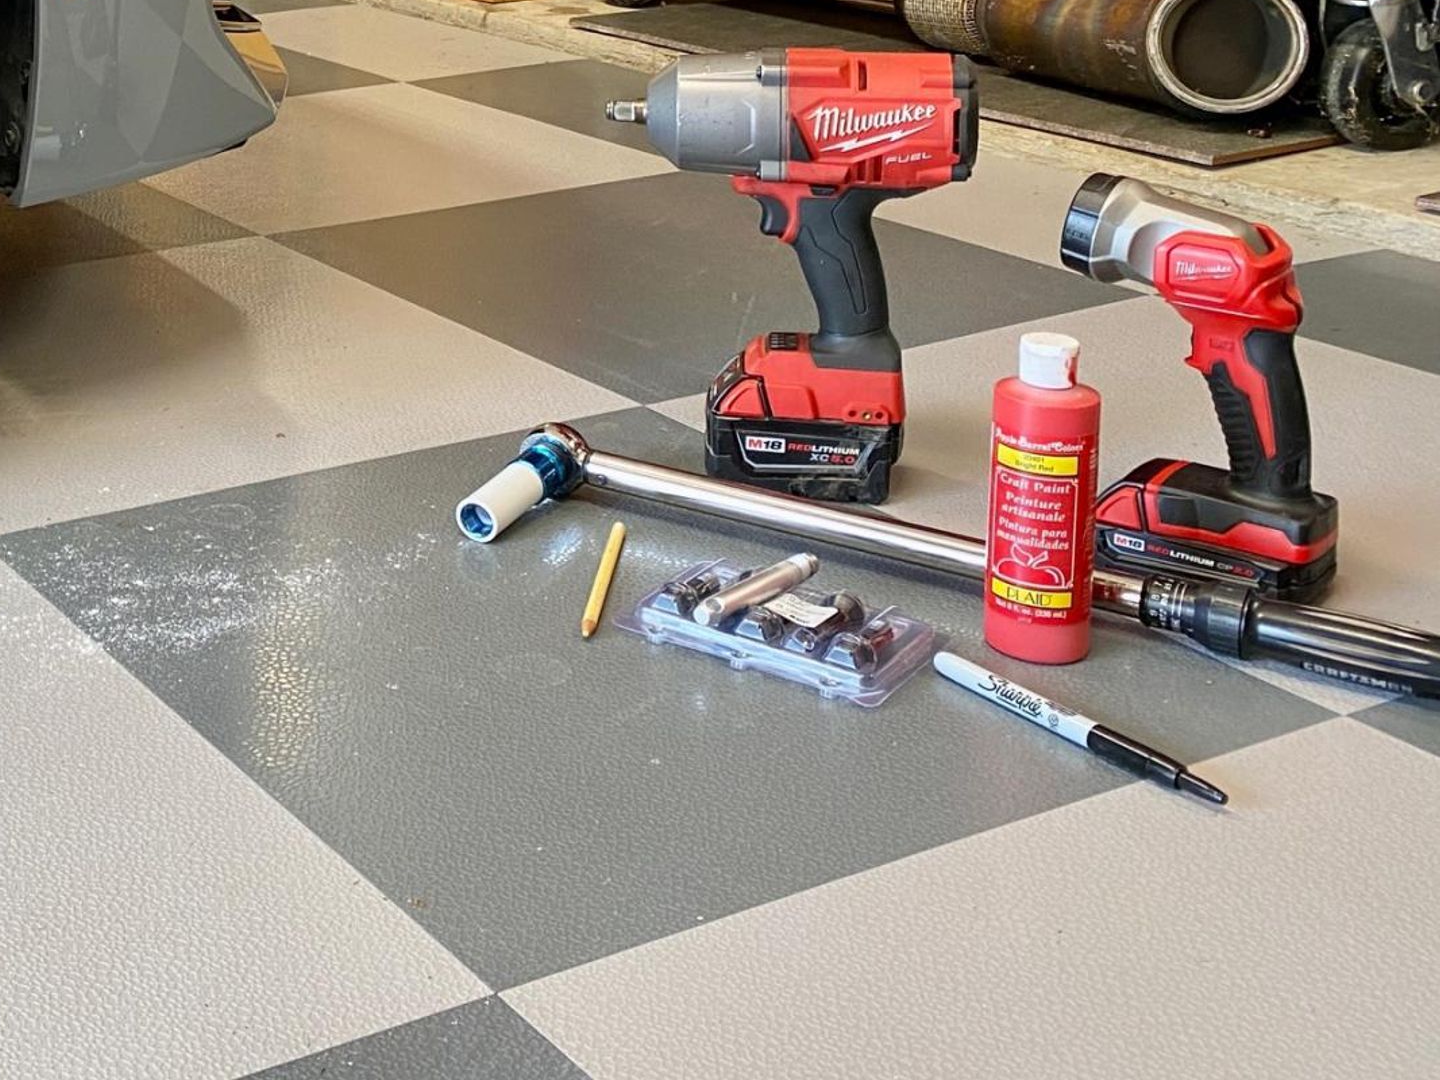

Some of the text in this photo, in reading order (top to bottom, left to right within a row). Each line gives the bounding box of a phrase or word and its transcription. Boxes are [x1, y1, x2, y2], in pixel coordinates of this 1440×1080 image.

[807, 103, 938, 140] Milwaukee
[885, 153, 933, 165] FUEL
[748, 438, 860, 456] M18 REDLITHIUM
[1000, 472, 1071, 494] Craft Paint
[1005, 491, 1062, 510] Peinture
[1001, 504, 1066, 523] artisanale
[998, 516, 1067, 539] Pintura para
[997, 529, 1069, 550] manualidades
[1115, 535, 1143, 550] M18
[1147, 543, 1214, 569] REDLITHIUM
[1006, 586, 1052, 606] PLAID
[1303, 661, 1413, 693] CRAFTSMAN
[978, 674, 1042, 716] Sharpie
